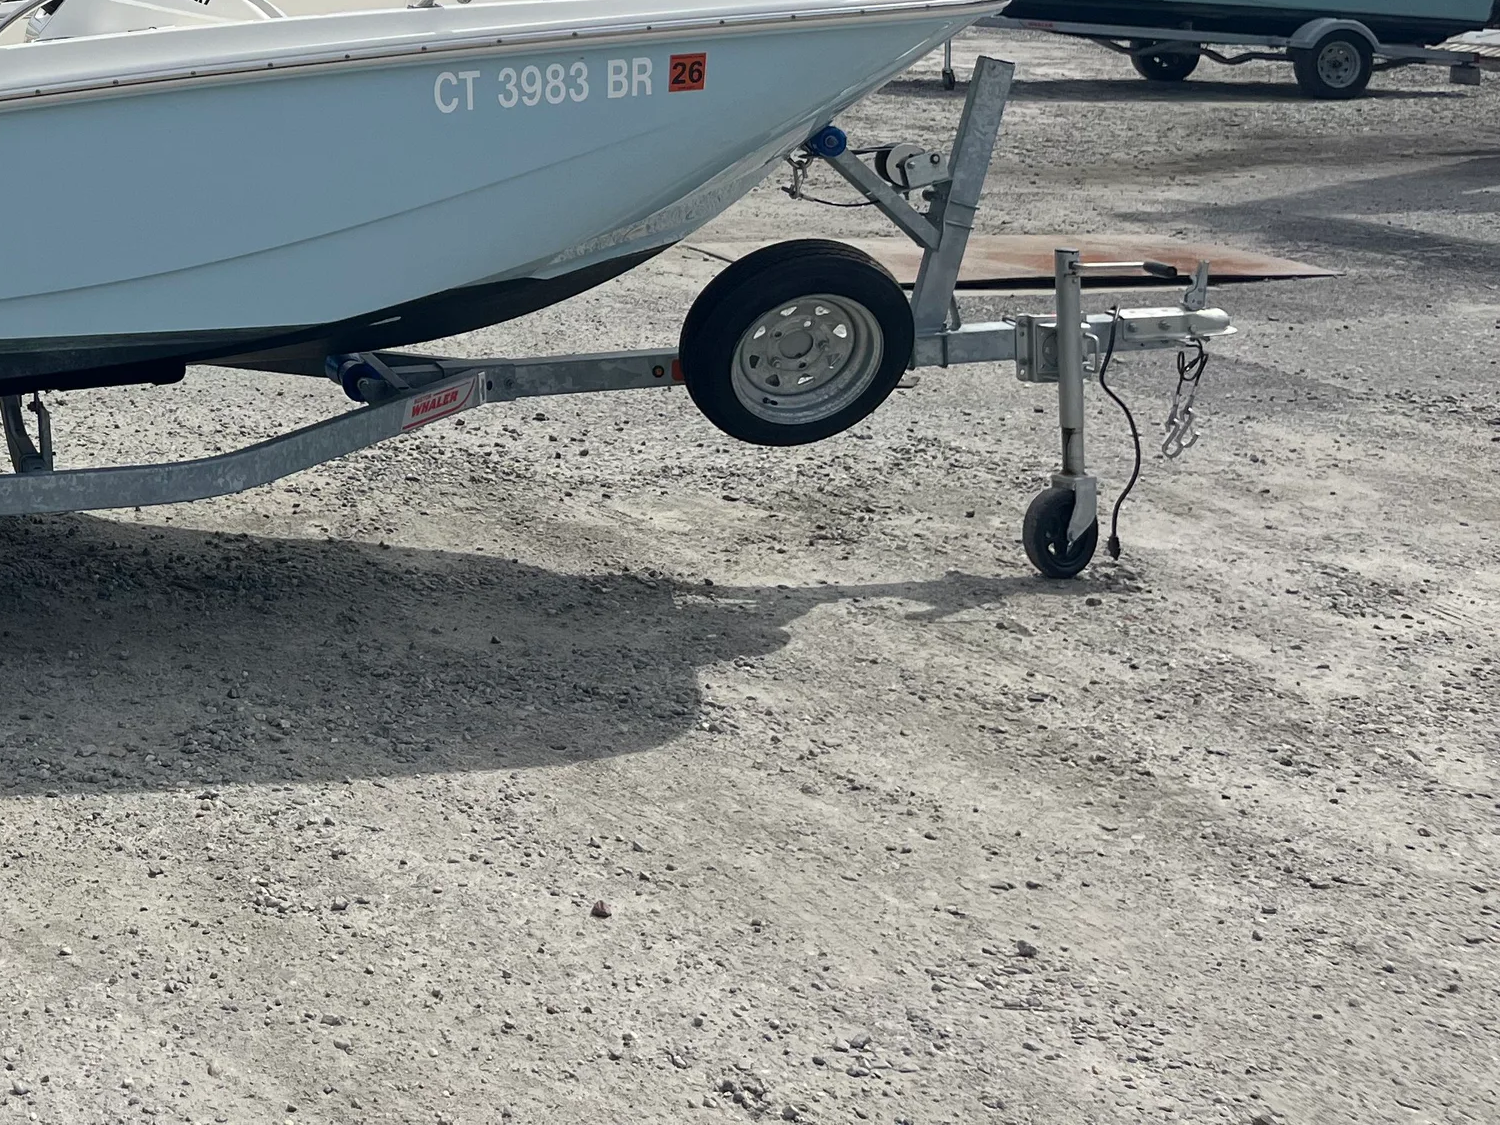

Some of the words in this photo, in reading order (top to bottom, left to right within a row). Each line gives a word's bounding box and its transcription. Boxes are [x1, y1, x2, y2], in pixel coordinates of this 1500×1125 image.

[434, 70, 481, 114] CT
[497, 61, 590, 109] 3983
[607, 57, 653, 99] BR
[671, 60, 703, 85] 26
[411, 389, 459, 418] WHALER
